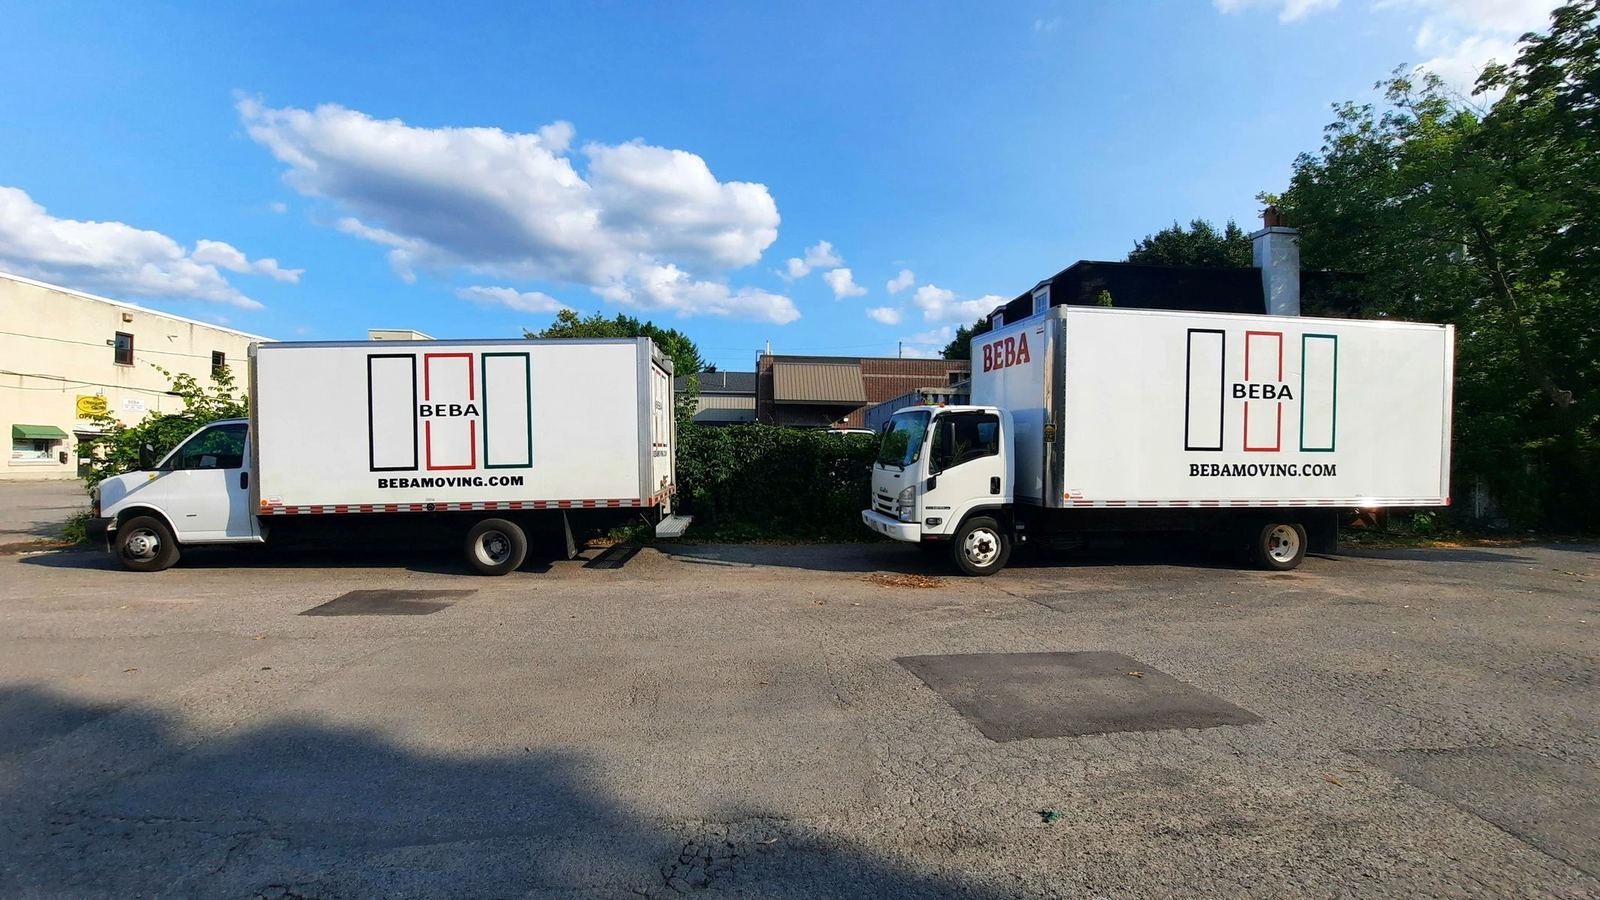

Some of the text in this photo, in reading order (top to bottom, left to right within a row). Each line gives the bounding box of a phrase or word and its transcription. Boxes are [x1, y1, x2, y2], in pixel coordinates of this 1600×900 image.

[982, 331, 1031, 373] BEBA
[1232, 383, 1293, 400] BEBA
[419, 403, 480, 418] BEBA
[1188, 463, 1337, 477] BEBAMOVING.COM
[377, 475, 524, 488] BEBAMOVING.COM
